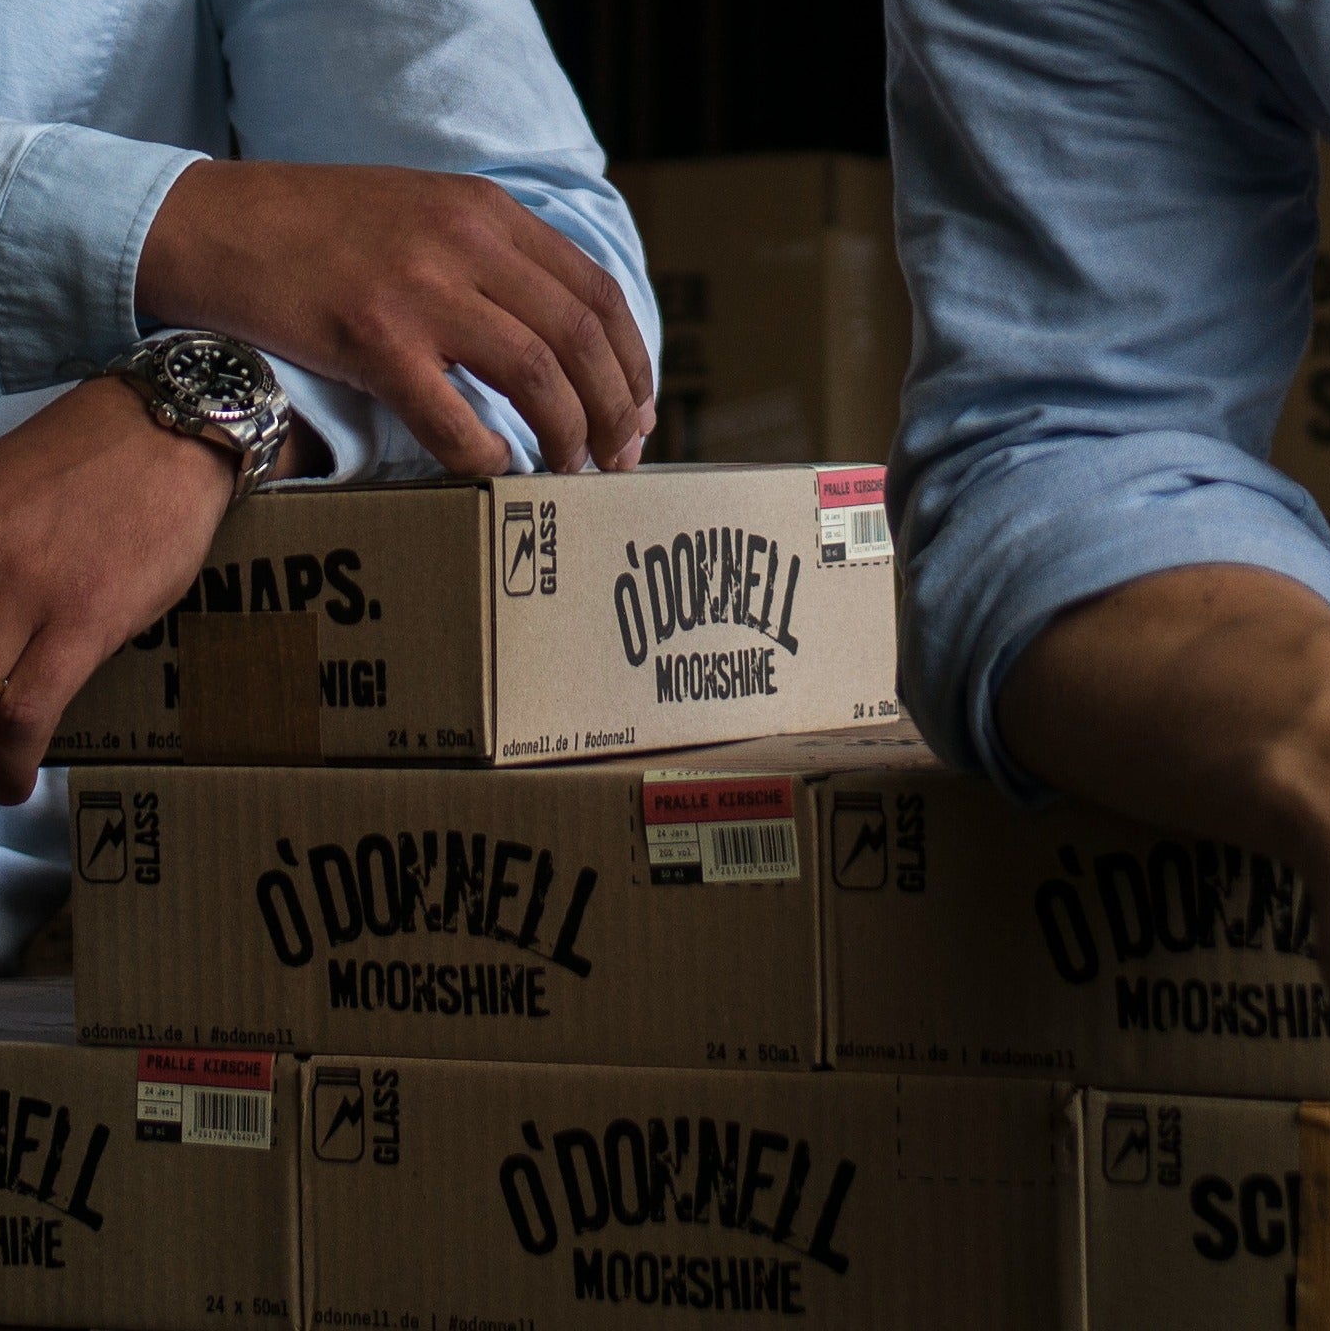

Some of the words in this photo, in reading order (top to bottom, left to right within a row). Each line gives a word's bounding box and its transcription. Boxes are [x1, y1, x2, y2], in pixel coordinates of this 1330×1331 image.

[540, 500, 557, 595] GLASS
[614, 527, 801, 667] O'DONNELL
[655, 648, 778, 705] MOONSHINE
[387, 729, 408, 747] 24
[417, 733, 428, 747] x
[436, 728, 475, 748] 50ml
[853, 704, 865, 719] 24
[877, 699, 899, 717] 50ml
[502, 734, 568, 757] odonnell.de
[584, 726, 636, 749] #odonnell
[654, 793, 709, 811] PRALLE
[718, 788, 783, 808] KIRSCHE
[134, 792, 161, 885] GLASS
[897, 792, 926, 892] GLASS
[256, 830, 598, 978] O'DONNELL
[1035, 840, 1319, 984] O'DONN
[328, 958, 550, 1017] MOONSHINE
[81, 1024, 183, 1041] odonnell.de
[210, 1028, 295, 1046] #odonnell
[706, 1042, 727, 1060] 24
[737, 1046, 747, 1061] x
[758, 1043, 800, 1063] 50ml
[835, 1042, 949, 1063] odonnell.de
[980, 1046, 1076, 1070] #odonnell
[146, 1054, 196, 1071] PRALLE
[203, 1057, 262, 1077] KIRSCHE
[373, 1069, 401, 1166] GLASS
[1157, 1106, 1182, 1187] GLASS
[499, 1116, 857, 1275] O'DONNELL
[205, 1296, 225, 1314] 24
[234, 1300, 243, 1313] x
[252, 1297, 290, 1317] 50ml
[573, 1247, 807, 1315] MOONSHINE
[313, 1307, 420, 1329] odonnell.de
